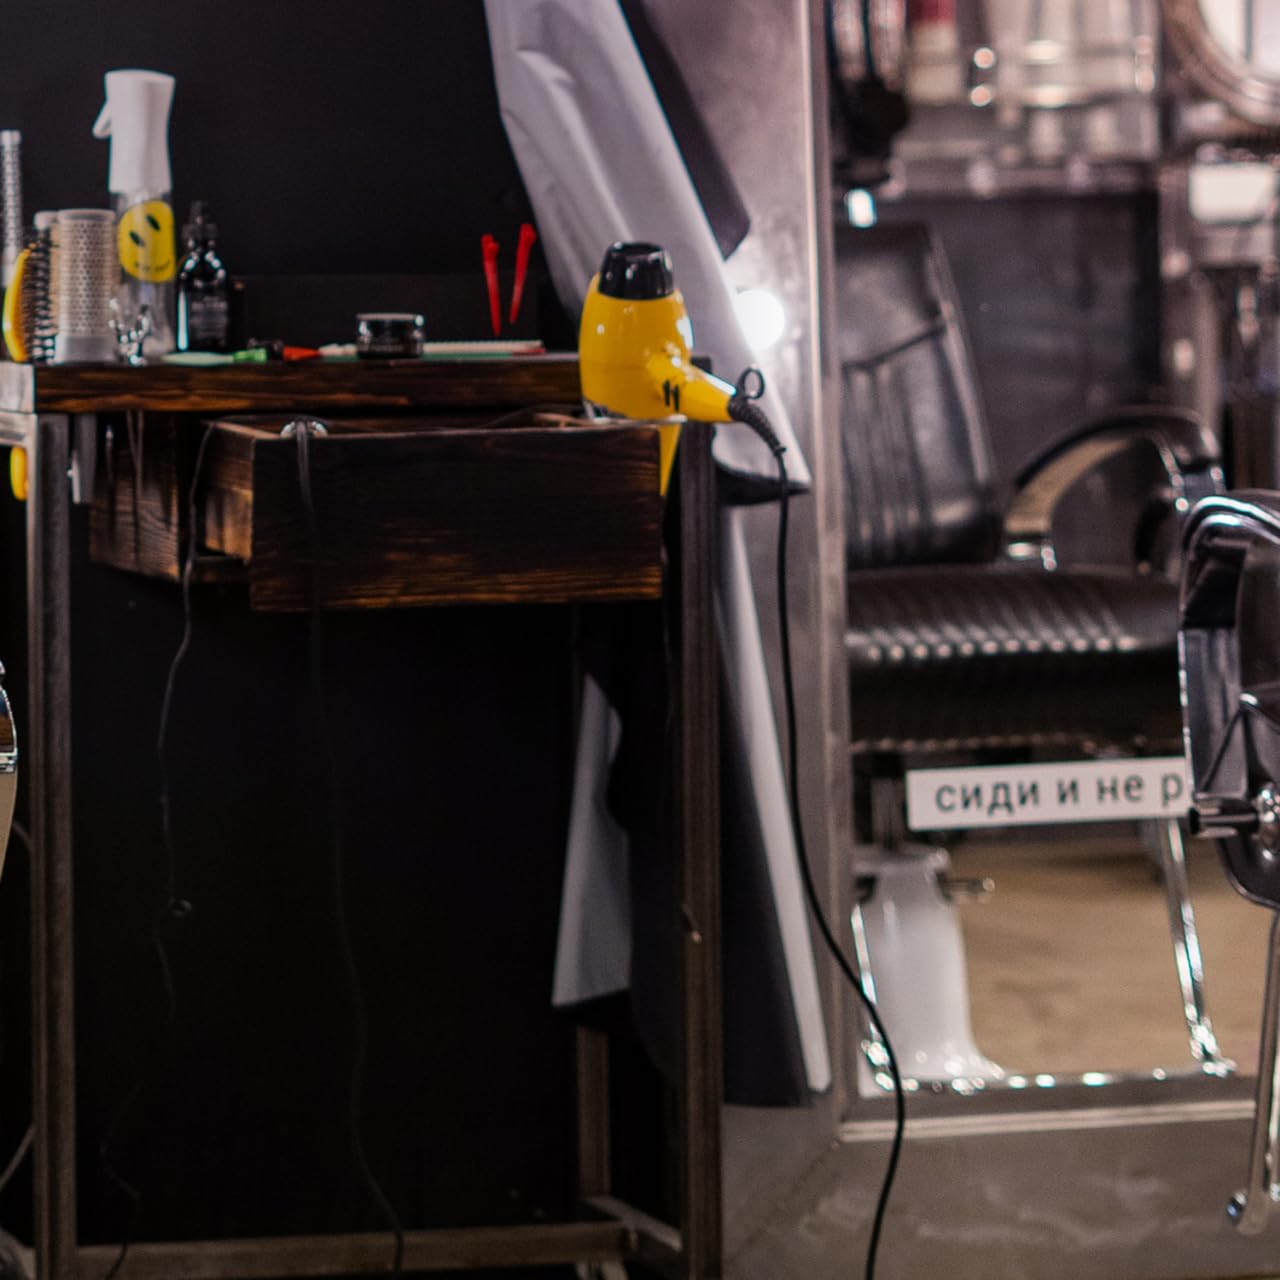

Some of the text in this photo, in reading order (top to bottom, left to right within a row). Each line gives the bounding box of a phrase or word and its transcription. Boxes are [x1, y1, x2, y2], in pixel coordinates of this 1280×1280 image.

[935, 778, 1040, 816] сиди
[1057, 778, 1080, 806] и
[1097, 772, 1144, 802] не
